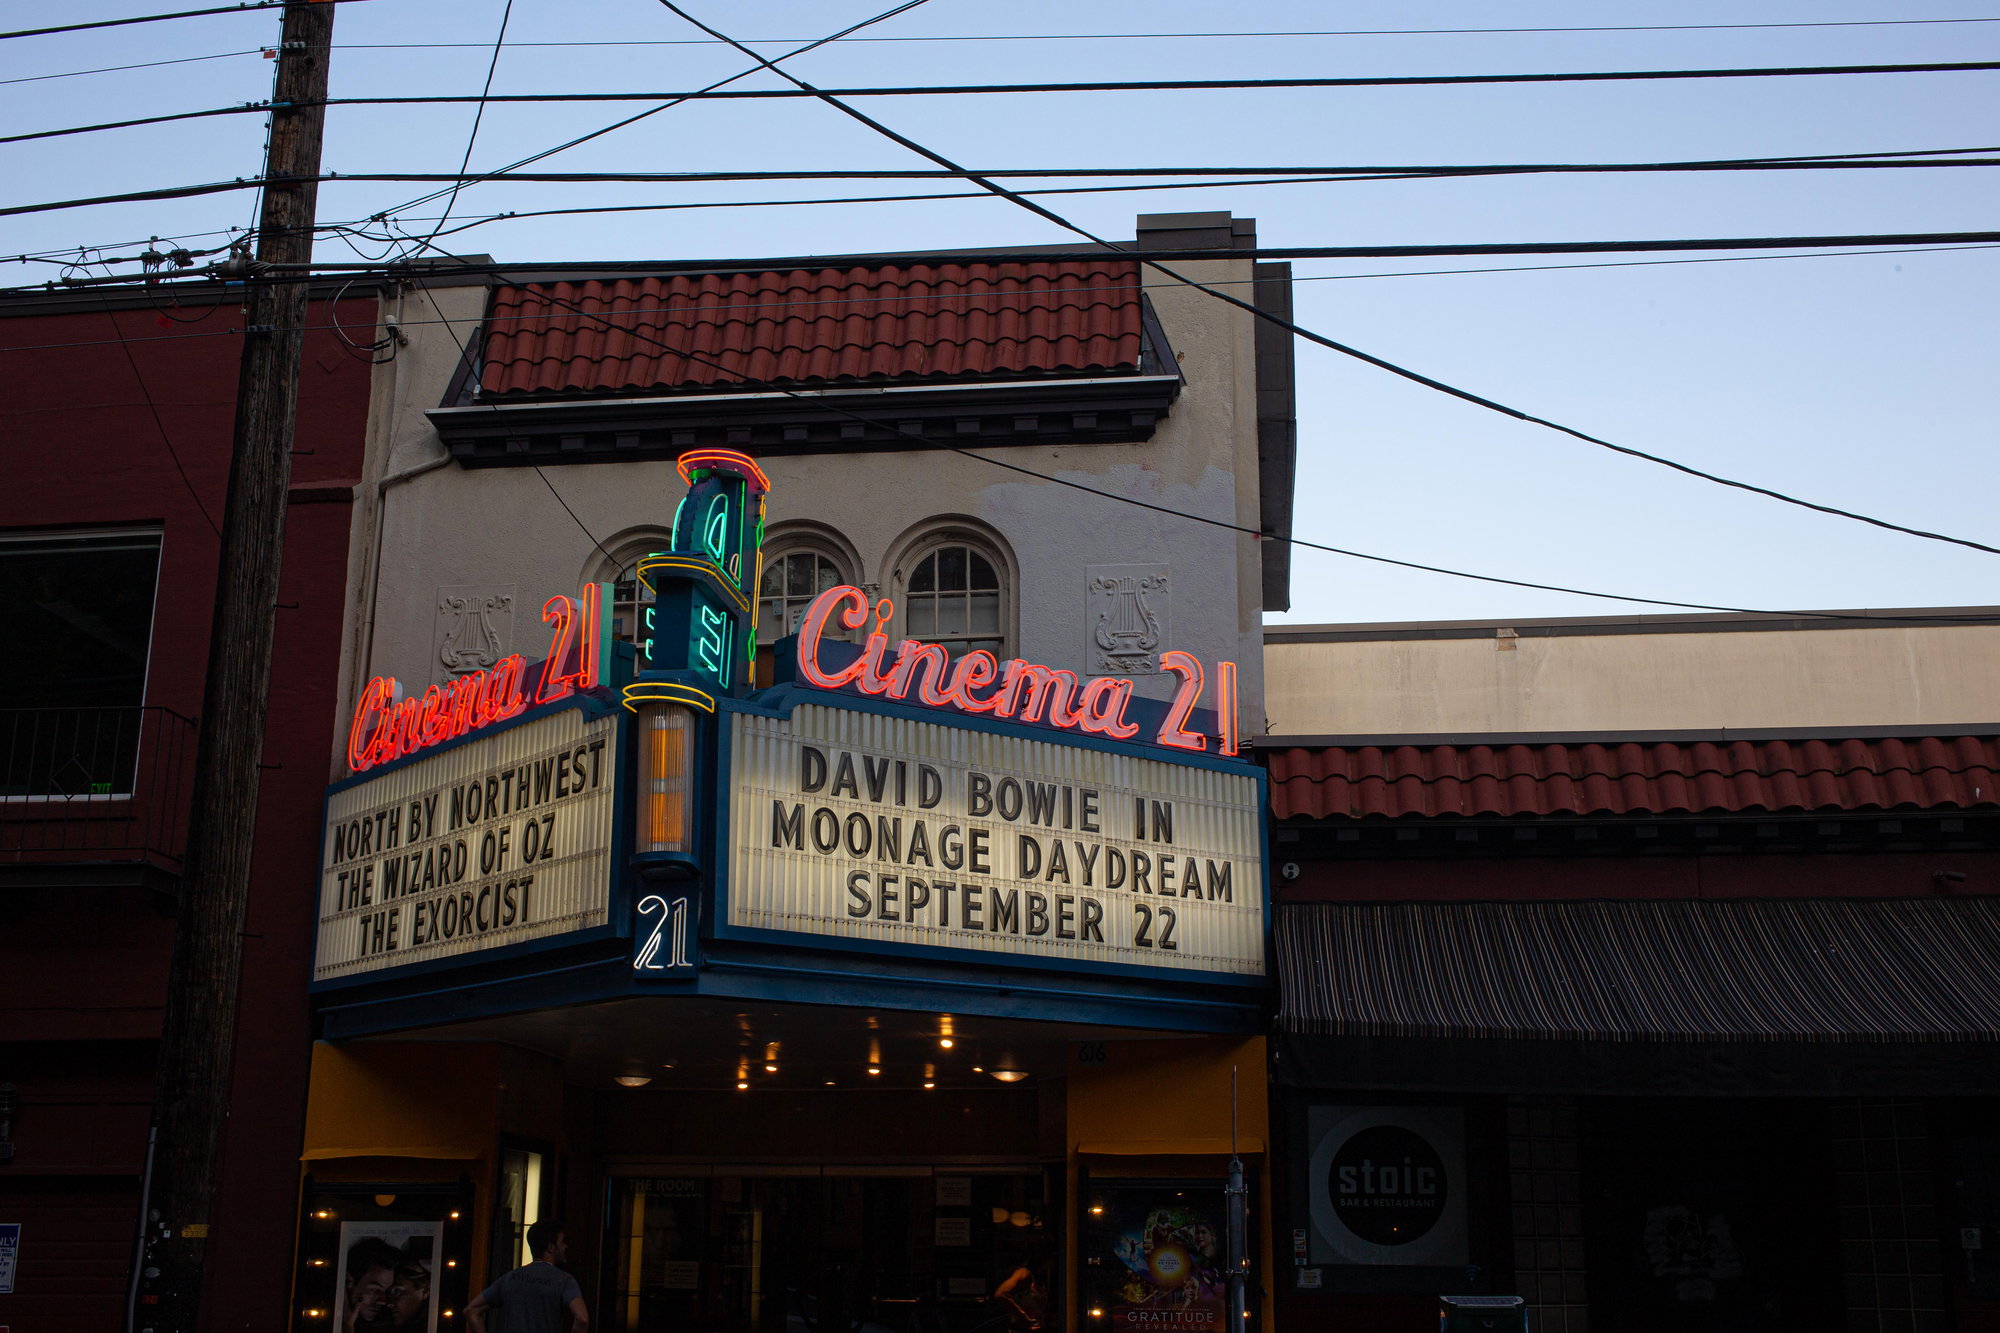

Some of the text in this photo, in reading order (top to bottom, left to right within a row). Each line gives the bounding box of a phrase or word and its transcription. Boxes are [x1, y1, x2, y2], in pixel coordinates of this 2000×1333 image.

[348, 582, 602, 772] Cinema 21
[796, 583, 1240, 757] Cinema 21
[333, 739, 606, 865] NORTH BY NORTHWEST
[801, 745, 1173, 844] DAVID BOWIE IN
[336, 812, 556, 912] THE WIZARD OF OZ
[772, 799, 1233, 903] MOONAGE DAYDREAM
[360, 875, 534, 957] THE EXORCIST
[633, 894, 694, 970] 21
[847, 869, 1178, 952] SEPTEMBER 22
[656, 1178, 696, 1192] ROOM
[1339, 1156, 1436, 1195] stoic
[1340, 1198, 1361, 1208] BAR
[1374, 1198, 1435, 1208] RESTAURANT
[1127, 1311, 1214, 1323] GRATITUDE
[1135, 1323, 1206, 1331] REVEALED
